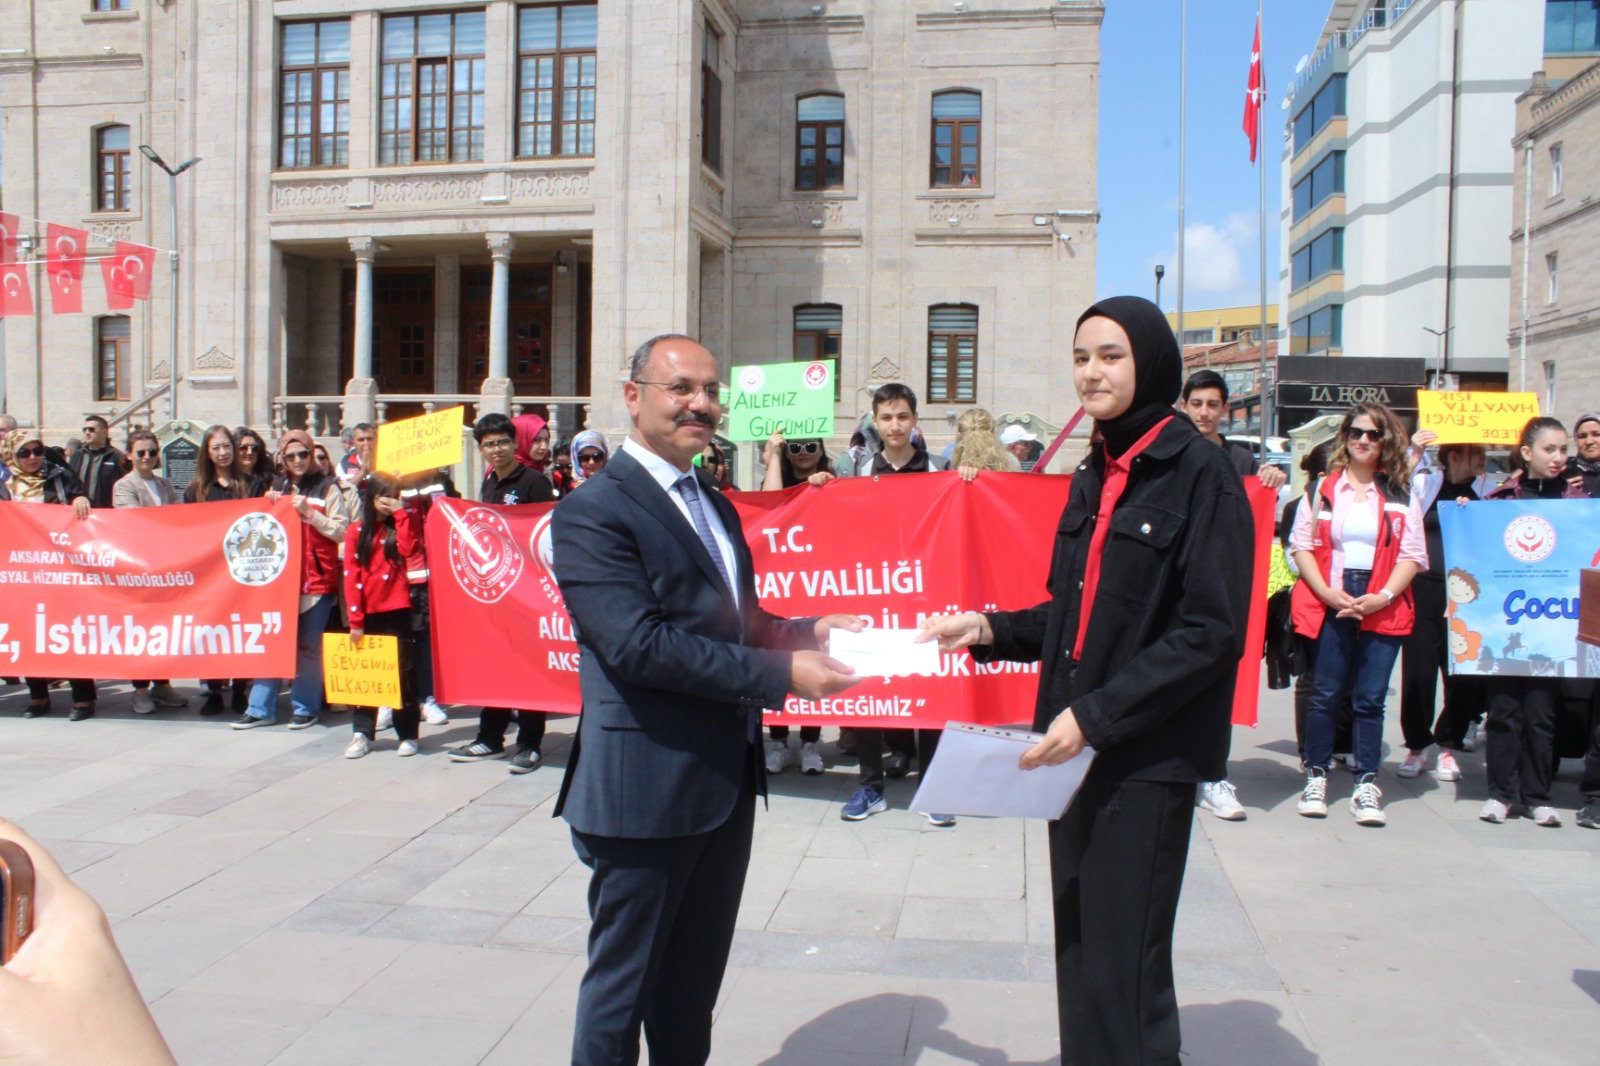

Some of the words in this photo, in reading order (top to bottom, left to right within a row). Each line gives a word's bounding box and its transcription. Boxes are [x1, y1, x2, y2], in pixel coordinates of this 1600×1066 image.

[1310, 386, 1333, 402] LA
[1338, 386, 1391, 403] HORA
[1444, 402, 1534, 413] HAYATTA
[1481, 429, 1521, 439] LEDE
[49, 532, 72, 546] T.C.
[762, 525, 813, 554] T.C.
[9, 550, 65, 564] AKSARAY
[33, 569, 102, 586] HİZMETLER
[103, 571, 115, 586] İL
[117, 571, 195, 588] MÜDÜRLÜĞÜ
[799, 560, 924, 598] VALİLİĞİ
[540, 576, 560, 604] 2025
